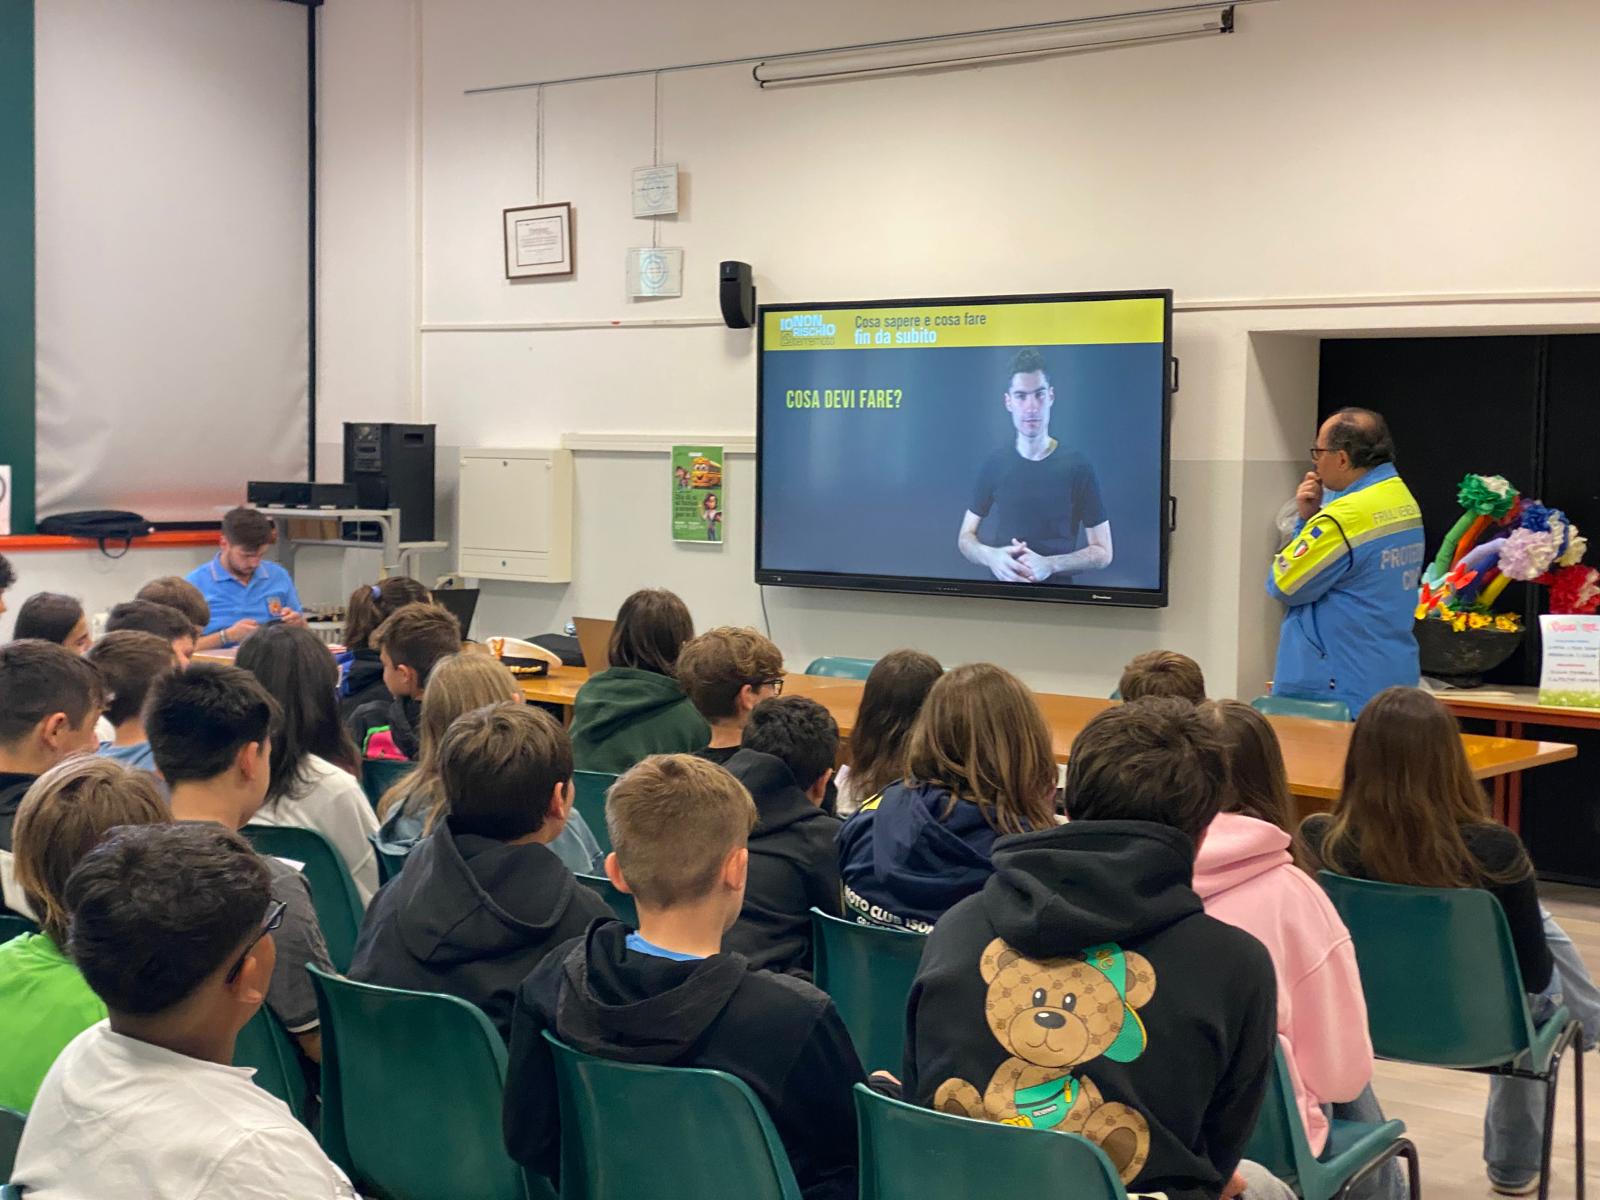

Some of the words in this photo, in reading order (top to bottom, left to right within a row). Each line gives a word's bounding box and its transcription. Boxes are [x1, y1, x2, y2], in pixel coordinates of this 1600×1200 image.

[855, 315, 880, 328] Cosa
[884, 315, 920, 329] sapere
[924, 316, 931, 326] e
[935, 314, 960, 326] cosa
[964, 312, 987, 325] fare
[854, 329, 870, 345] fin
[875, 328, 890, 344] da
[895, 327, 937, 344] subito
[786, 390, 820, 409] COSA
[824, 390, 855, 408] DEVI
[859, 389, 903, 408] FARE?
[870, 905, 902, 924] CLUB
